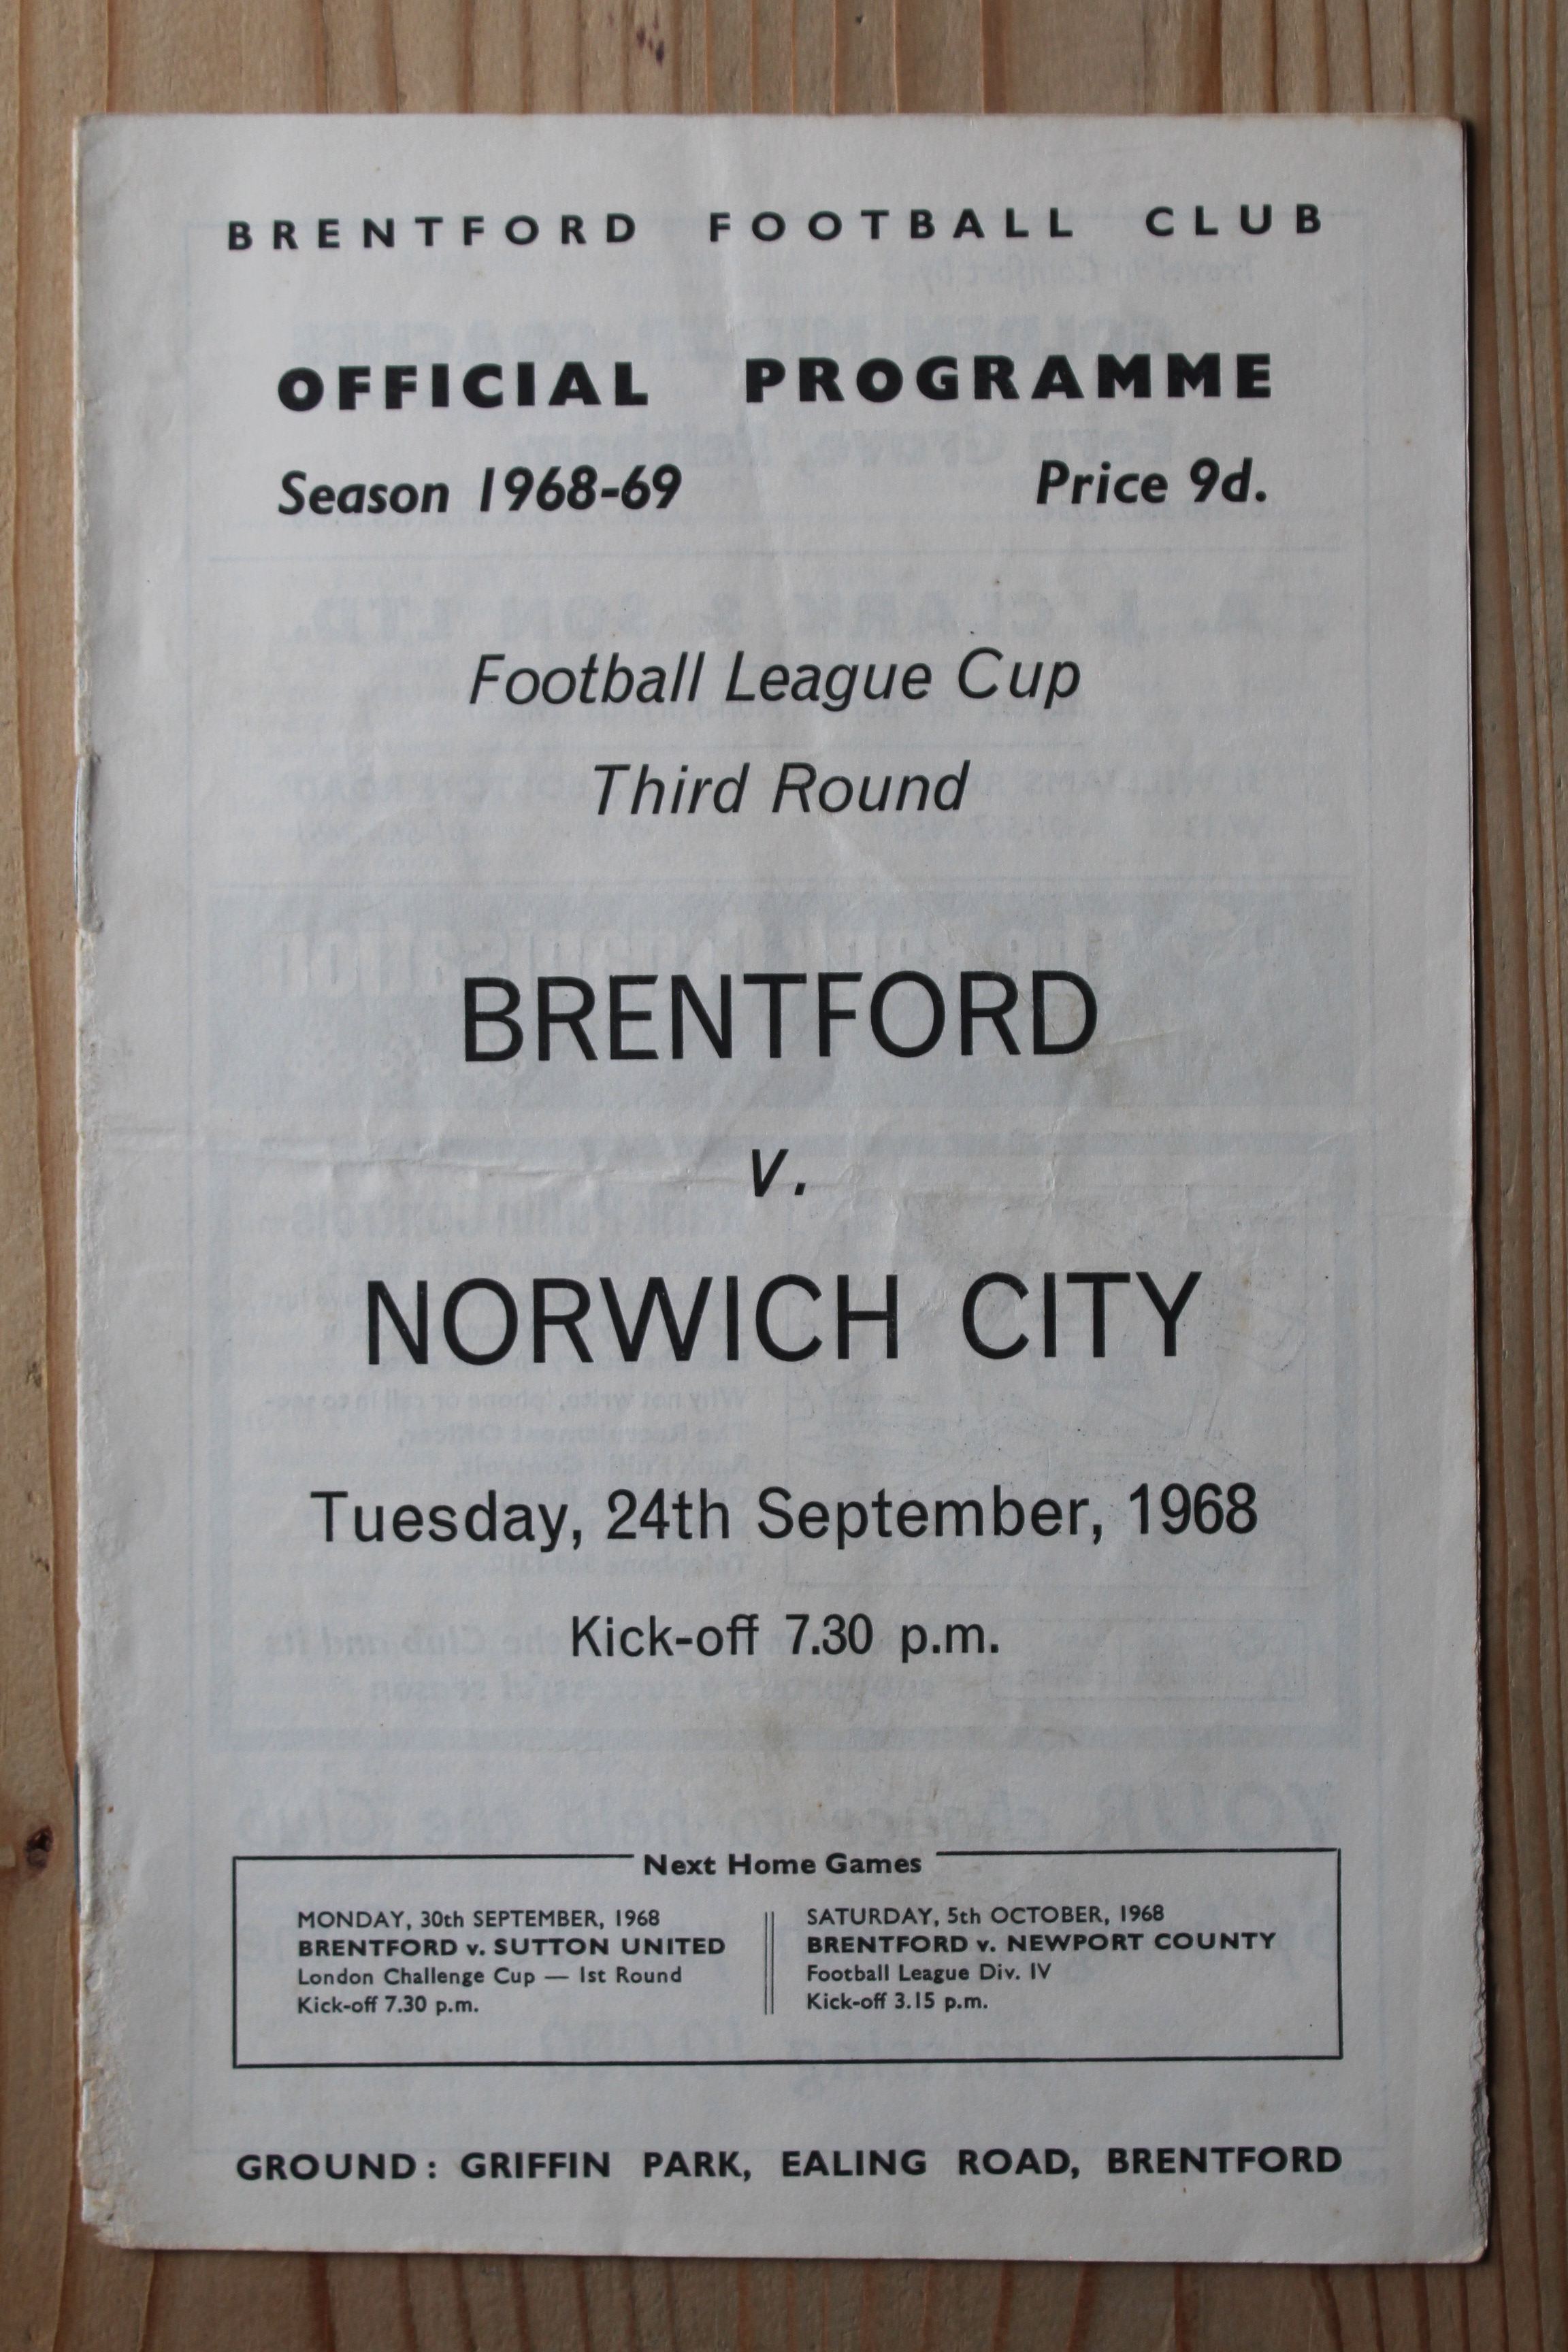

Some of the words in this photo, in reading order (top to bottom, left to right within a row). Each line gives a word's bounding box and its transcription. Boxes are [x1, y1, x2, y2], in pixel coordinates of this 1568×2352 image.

[228, 212, 636, 251] BRENTFORD
[709, 207, 1073, 243] FOOTBALL
[1145, 203, 1322, 238] CLUB
[277, 361, 649, 412] OFFICIAL
[745, 352, 1271, 404] PROGRAMME
[278, 470, 450, 516] Season
[480, 463, 683, 512] 1968-69
[1036, 459, 1169, 505] Price
[1190, 457, 1267, 503] 9d.
[469, 651, 706, 705] Football
[725, 650, 932, 713] League
[958, 647, 1081, 710] Cup
[593, 762, 751, 815] Third
[771, 759, 971, 813] Round
[463, 970, 1098, 1062] BRENTFORD
[751, 1148, 806, 1198] v.
[367, 1273, 898, 1367] NORWICH
[962, 1271, 1203, 1360] CITY
[310, 1489, 582, 1553] Tuesday,
[606, 1487, 730, 1540] 24th
[757, 1484, 1102, 1550] September,
[1129, 1482, 1258, 1535] 1968
[572, 1613, 760, 1658] Kick-off
[785, 1612, 874, 1656] 7.30
[901, 1623, 999, 1664] p.m.
[644, 1854, 717, 1876] Next
[728, 1852, 817, 1876] Home
[825, 1852, 922, 1875] Games
[297, 1910, 412, 1931] MONDAY,
[421, 1910, 464, 1928] 30th
[473, 1909, 604, 1930] SEPTEMBER,
[616, 1909, 660, 1927] 1968
[807, 1906, 940, 1928] SATURDAY,
[947, 1906, 981, 1925] 5th
[990, 1905, 1110, 1926] OCTOBER,
[1121, 1904, 1164, 1923] 1968
[298, 1938, 458, 1957] BRENTFORD
[466, 1944, 486, 1957] v.
[494, 1938, 609, 1956] SUTTON
[621, 1937, 725, 1955] UNITED
[807, 1935, 968, 1954] BRENTFORD
[976, 1940, 996, 1953] v.
[1007, 1933, 1145, 1953] NEWPORT
[1154, 1931, 1277, 1950] COUNTY
[298, 1967, 374, 1985] London
[383, 1966, 485, 1988] Challenge
[493, 1966, 536, 1988] Cup
[580, 1965, 606, 1984] 1st
[616, 1965, 682, 1984] Round
[807, 1963, 889, 1982] Football
[898, 1963, 970, 1984] League
[979, 1963, 1021, 1981] Div.
[1030, 1962, 1051, 1980] IV
[297, 1995, 379, 2014] Kick-off
[385, 1995, 427, 2013] 7.30
[436, 2000, 479, 2016] p.m.
[807, 1991, 888, 2010] Kick-off
[894, 1991, 935, 2010] 3.15
[945, 1996, 988, 2013] p.m.
[460, 2151, 610, 2179] GRIFFIN
[644, 2151, 751, 2183] PARK,
[782, 2149, 927, 2177] EALING
[958, 2148, 1080, 2180] ROAD,
[1107, 2145, 1343, 2174] BRENTFORD
